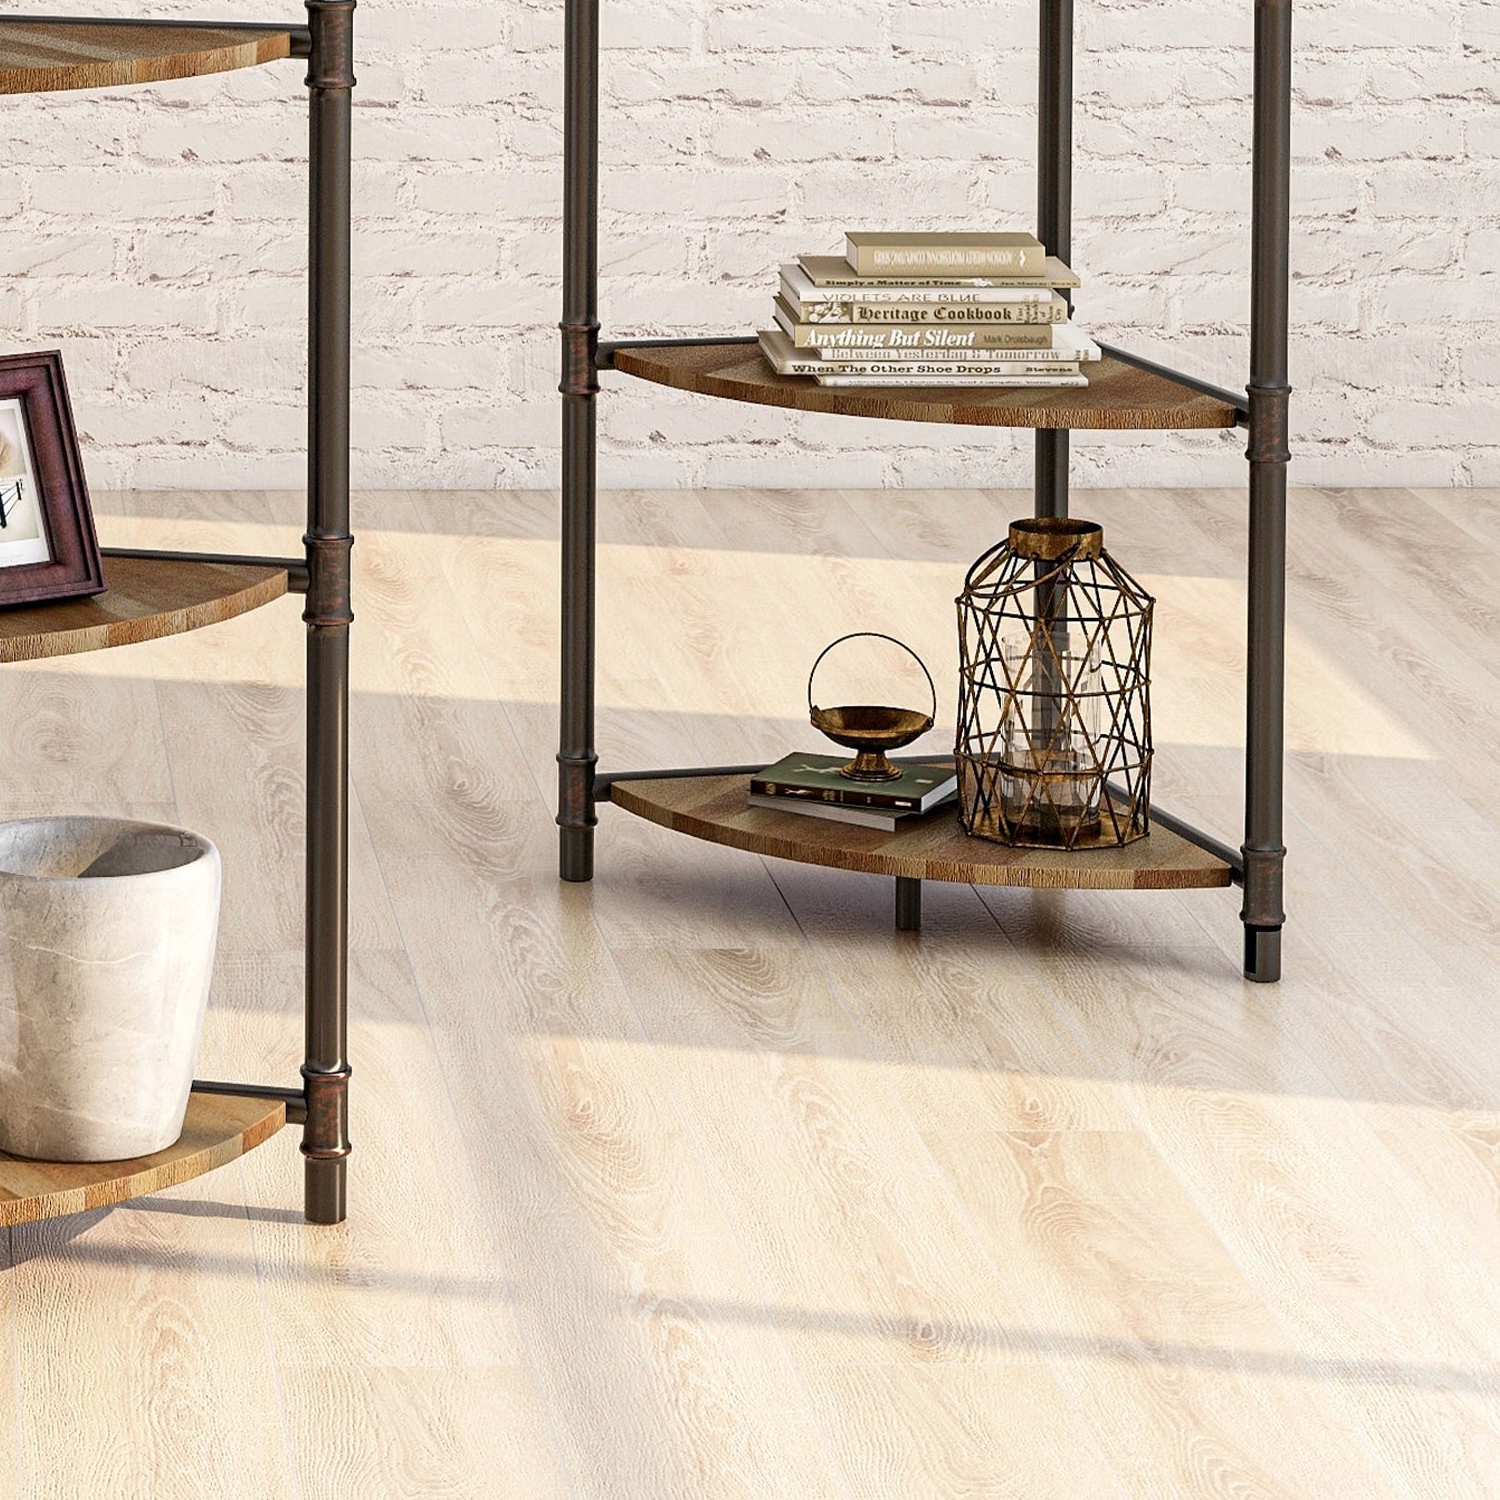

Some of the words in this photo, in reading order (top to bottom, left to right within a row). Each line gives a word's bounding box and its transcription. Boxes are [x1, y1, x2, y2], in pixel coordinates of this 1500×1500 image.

[825, 279, 865, 287] Simply
[822, 293, 891, 301] VIOLETS
[896, 293, 931, 301] ARE
[858, 306, 928, 322] Heritage
[933, 306, 1012, 320] Cookbook
[804, 329, 886, 347] Anything
[888, 329, 921, 346] But
[923, 328, 975, 346] Silent
[983, 334, 1002, 343] Mark
[832, 348, 891, 359] Between
[895, 348, 967, 361] Yesterday
[985, 349, 1061, 360] Tomorrow
[791, 364, 835, 373] When
[838, 364, 867, 373] The
[870, 364, 914, 373] Other
[916, 364, 953, 373] Shoe
[956, 364, 1001, 374] Drops
